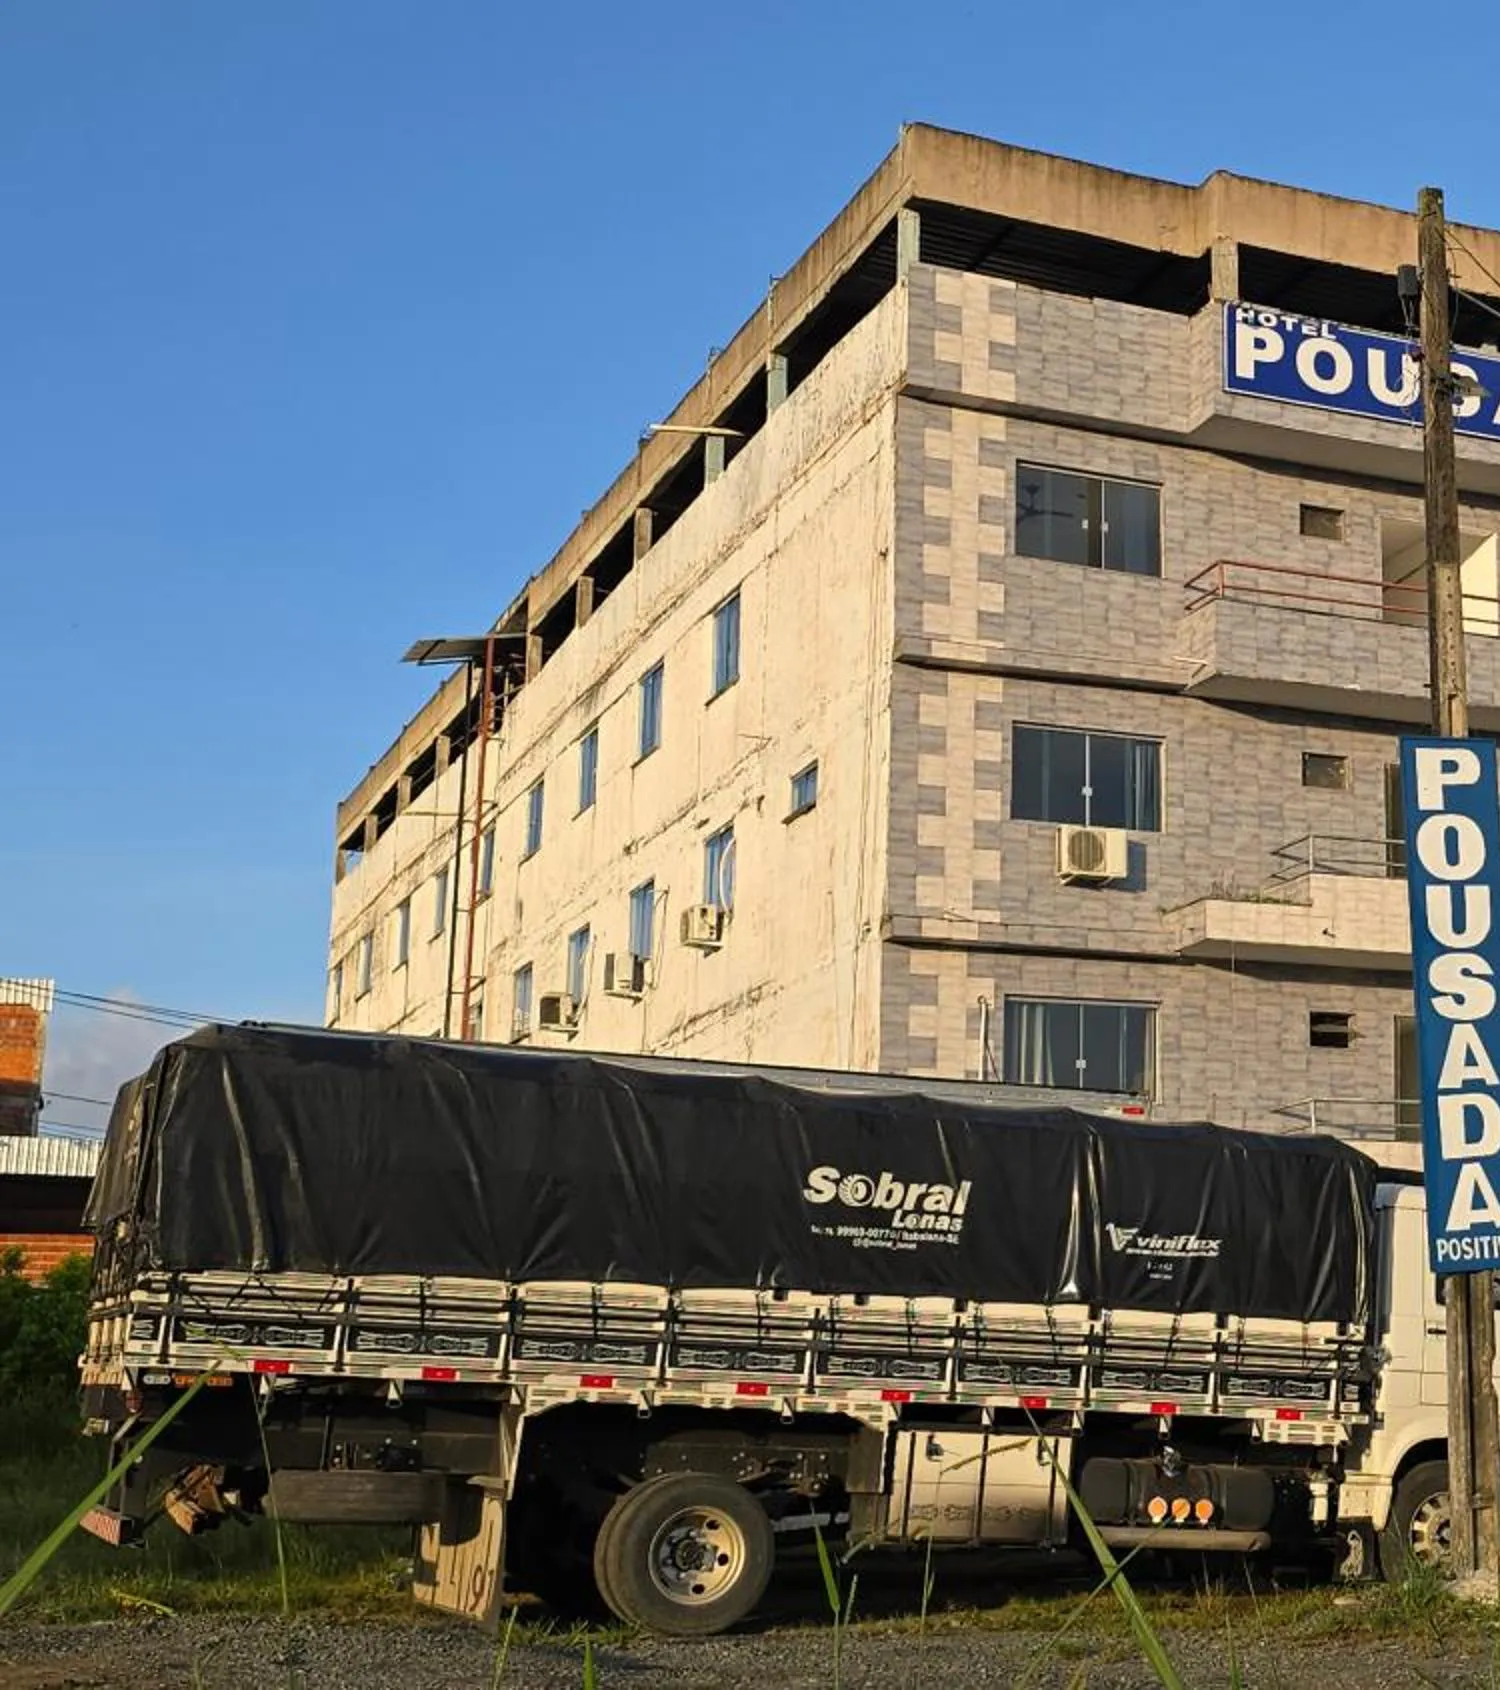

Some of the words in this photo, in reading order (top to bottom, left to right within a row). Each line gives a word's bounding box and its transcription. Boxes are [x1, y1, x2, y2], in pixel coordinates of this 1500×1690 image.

[1235, 308, 1337, 340] HOTEL
[803, 1166, 972, 1215] Sobral
[892, 1209, 964, 1232] Lonas
[1136, 1234, 1223, 1251] viniflex
